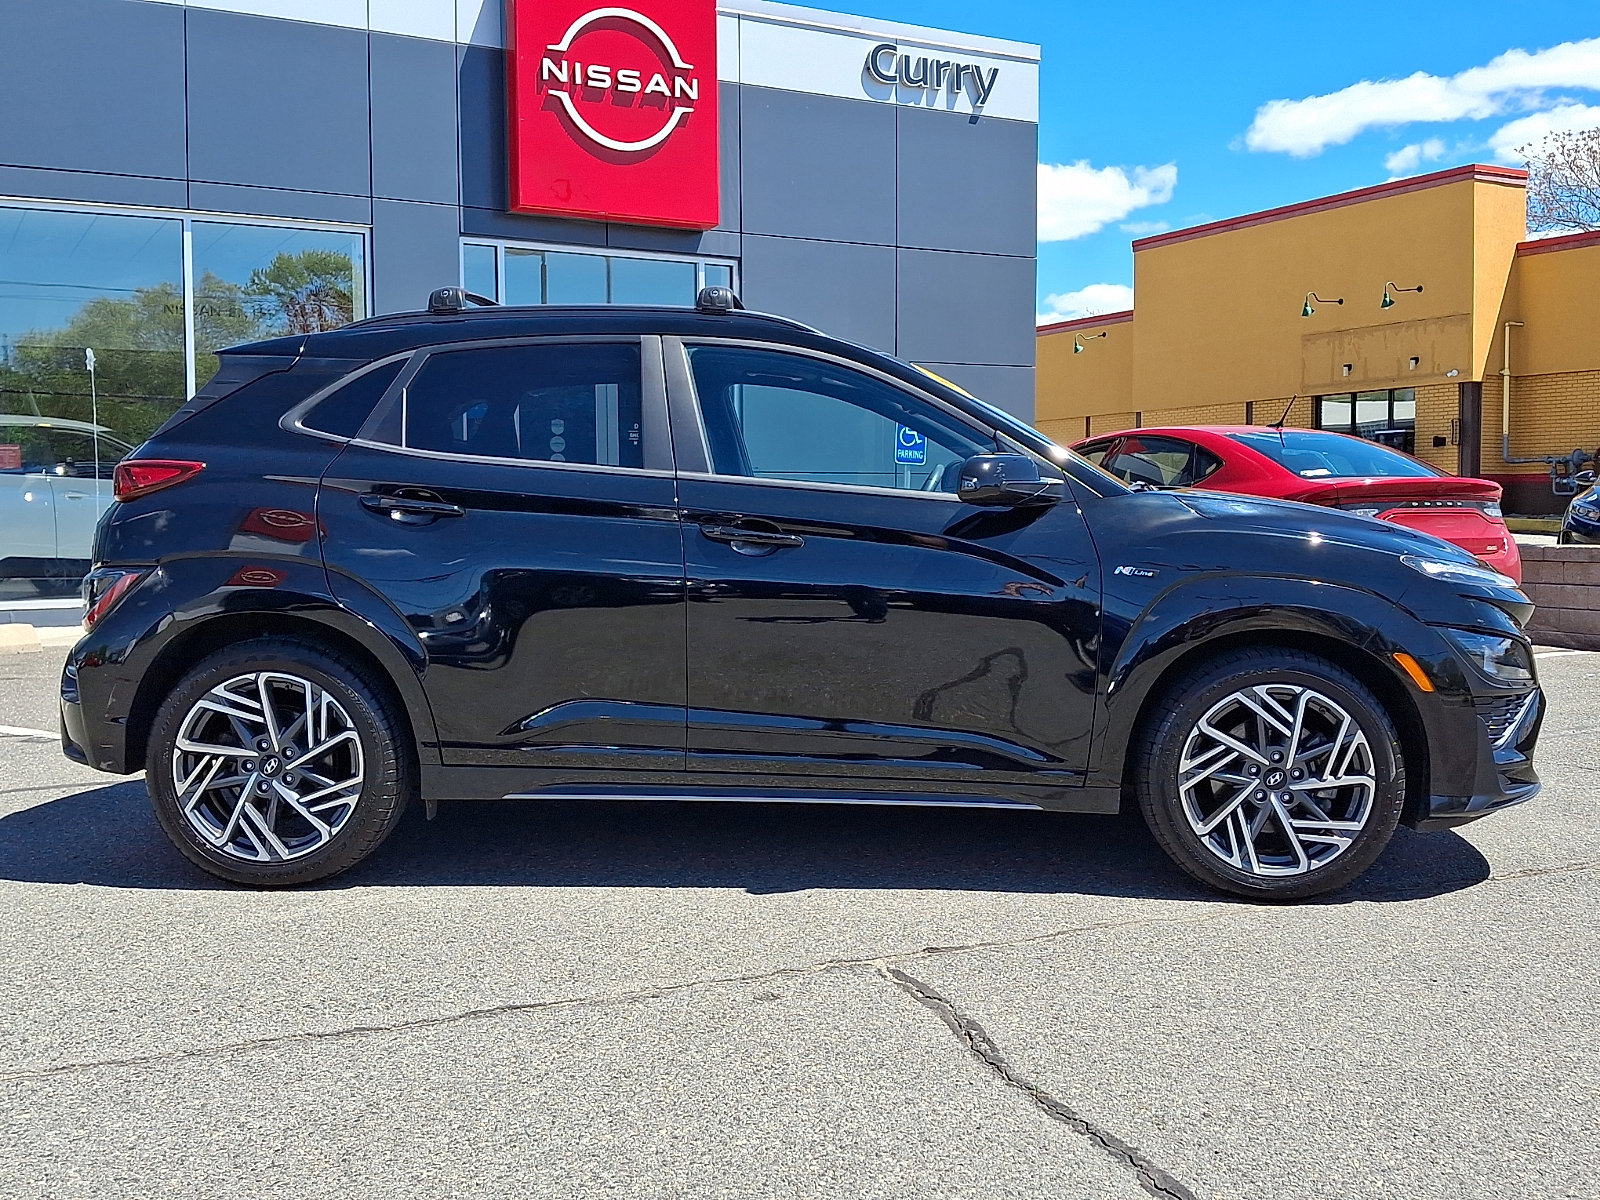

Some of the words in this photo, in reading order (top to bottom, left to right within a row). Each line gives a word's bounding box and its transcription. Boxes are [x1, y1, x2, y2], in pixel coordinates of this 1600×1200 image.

[542, 57, 699, 101] NISSAN
[870, 43, 1000, 105] Curry
[898, 449, 923, 459] PARKING
